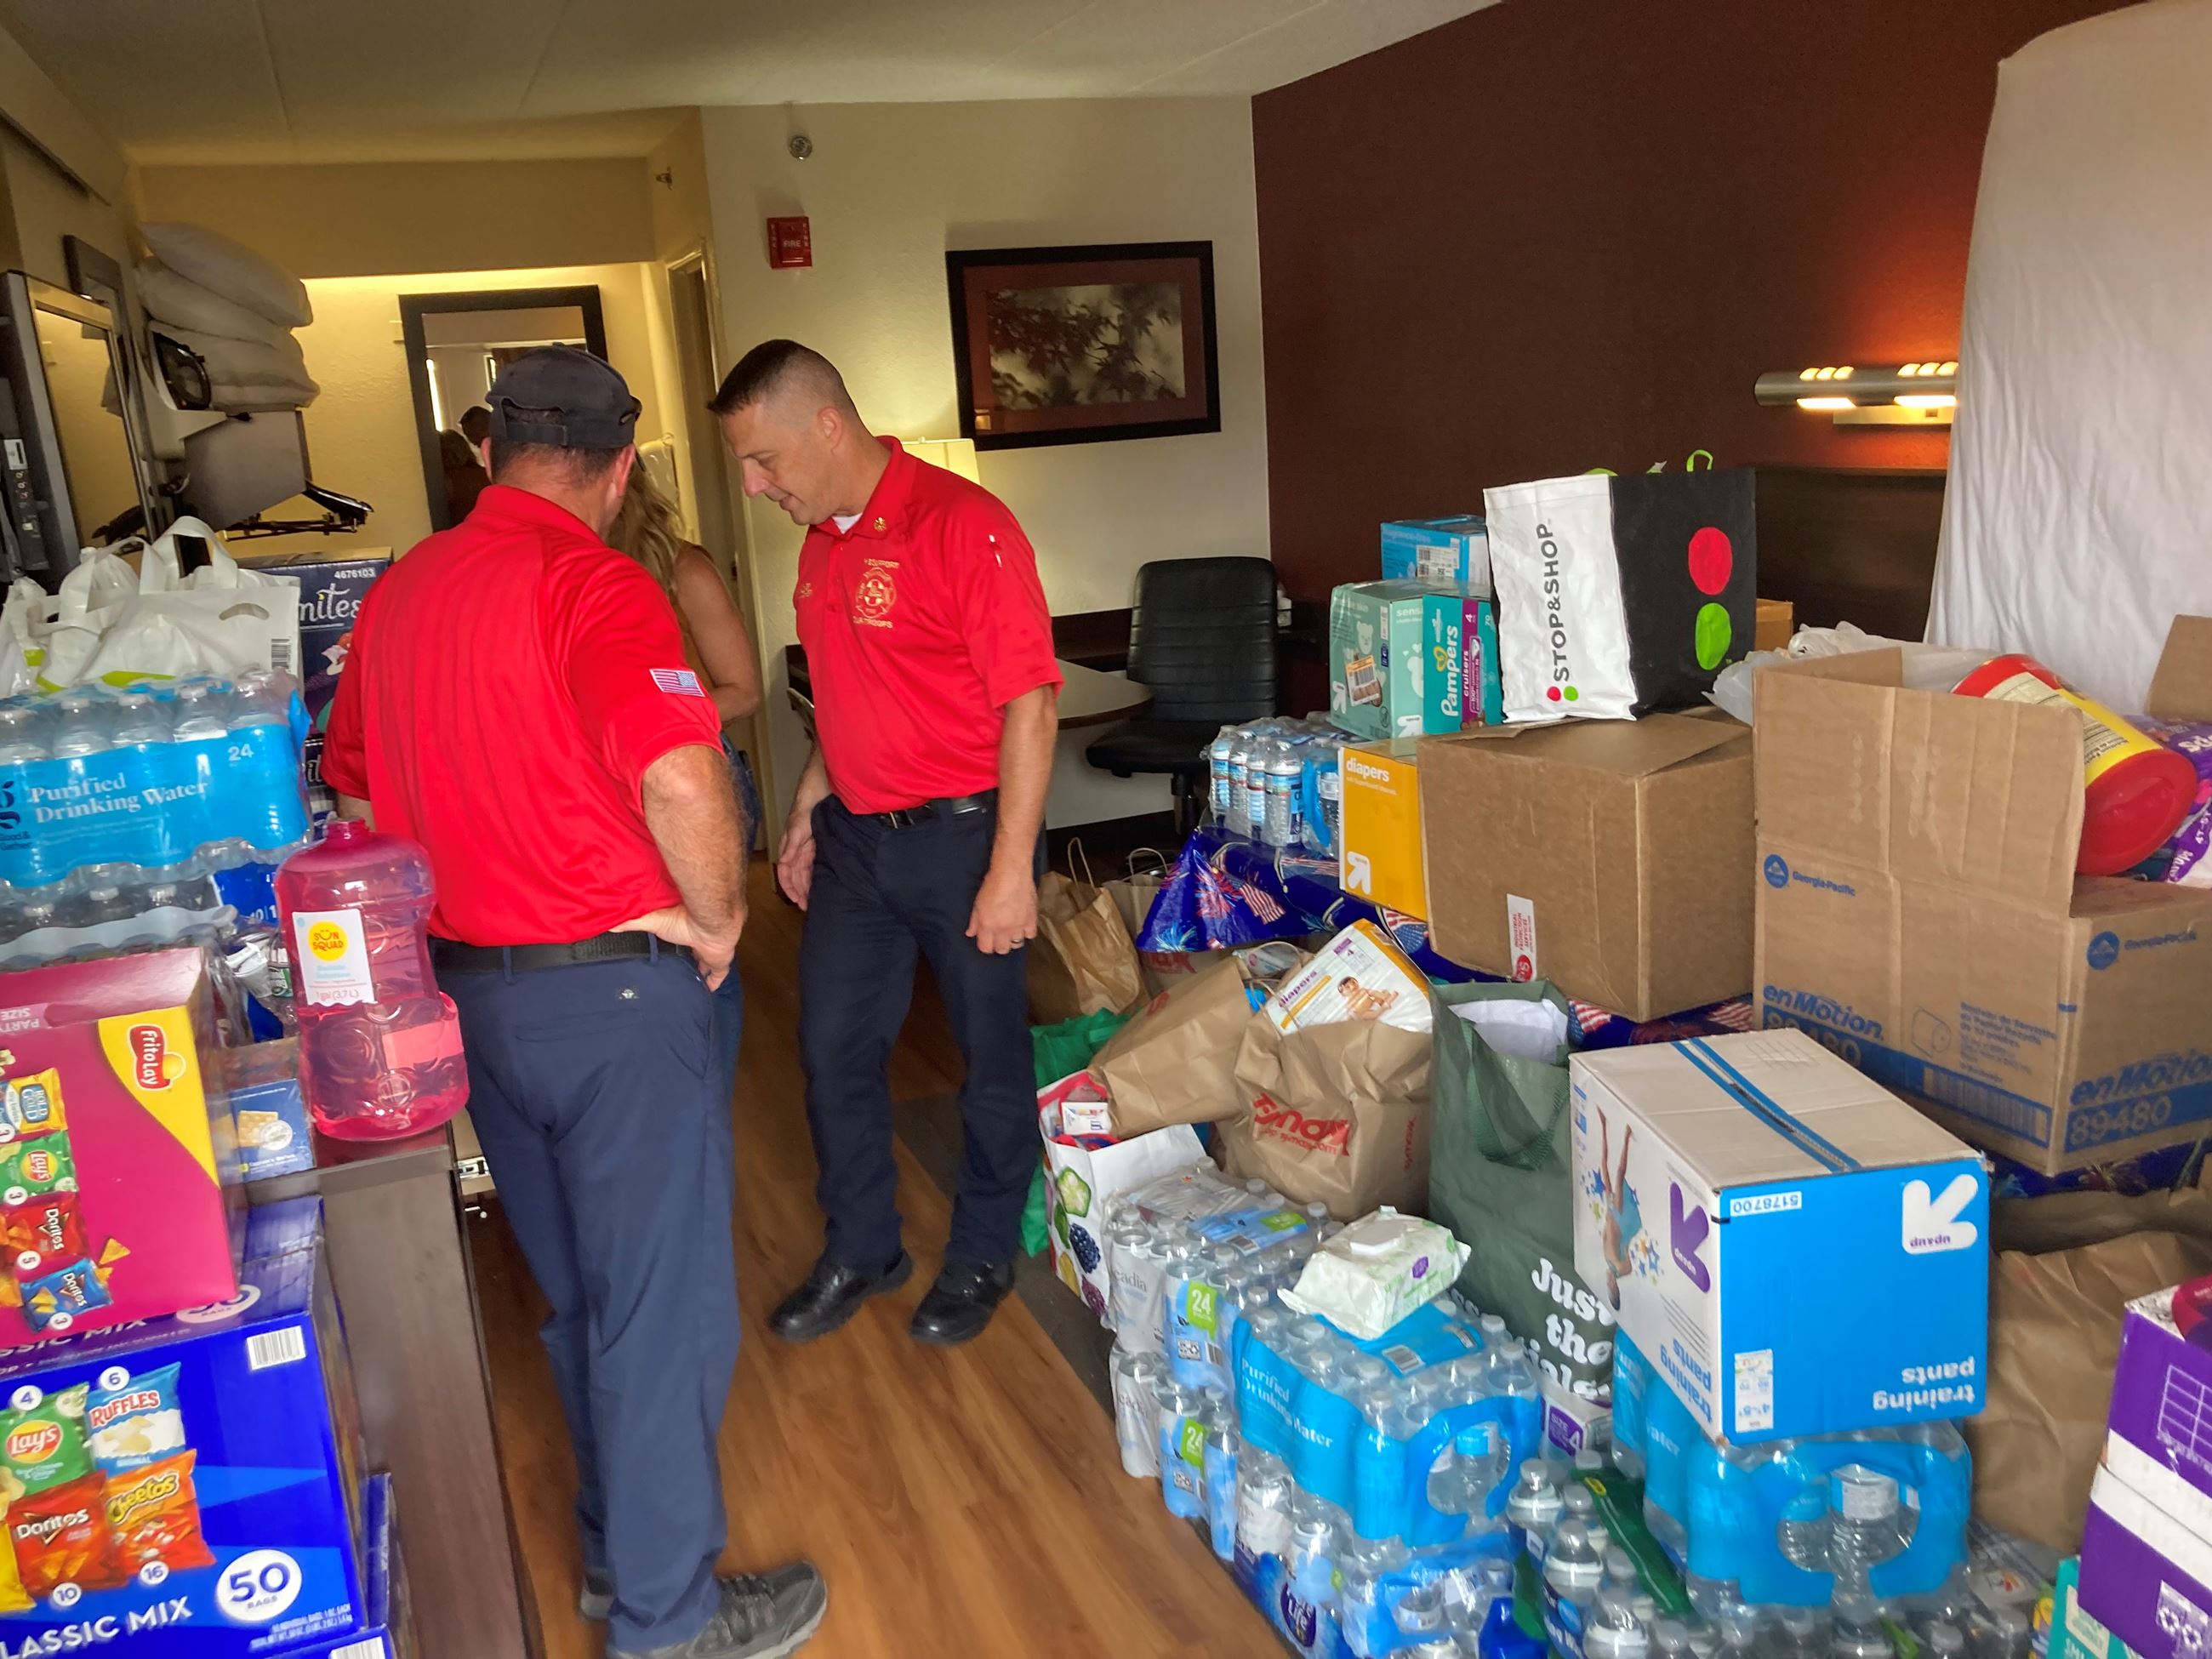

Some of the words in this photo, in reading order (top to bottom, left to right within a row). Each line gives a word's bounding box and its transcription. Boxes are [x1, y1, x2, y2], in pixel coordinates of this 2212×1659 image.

[783, 239, 801, 248] FIRE
[334, 567, 376, 579] 4676103
[1465, 613, 1473, 623] 4
[1440, 624, 1460, 716] Pampers
[227, 743, 254, 761] 24
[1346, 757, 1390, 783] diapers
[30, 772, 127, 803] Purified
[35, 794, 141, 823] Drinking
[142, 781, 208, 806] Water
[1793, 870, 1856, 897] Georgia-Pacific
[312, 940, 344, 952] SQUAD
[1279, 971, 1318, 1007] diapers
[1, 1007, 31, 1019] SIZE
[2070, 1048, 2212, 1106] enMotio
[22, 1088, 38, 1120] GOLD
[37, 1089, 48, 1117] ROLD
[2071, 1096, 2171, 1146] 89480
[1733, 1194, 1799, 1214] 5178700
[45, 1208, 65, 1251] Doritos
[1910, 1234, 1951, 1249] up&up
[22, 1256, 37, 1265] 5
[63, 1272, 88, 1307] Doritos
[1191, 1289, 1212, 1314] 24
[55, 1317, 68, 1325] 3
[108, 1371, 121, 1386] 6
[1673, 1337, 1713, 1394] pants
[1901, 1355, 1975, 1386] pants
[1241, 1357, 1291, 1403] Purified
[1660, 1342, 1713, 1424] training
[20, 1390, 34, 1405] 4
[89, 1390, 160, 1428] RUFFLES
[1873, 1383, 1975, 1413] training
[1551, 1411, 1568, 1431] SIZE
[1187, 1426, 1204, 1448] 24
[1569, 1430, 1581, 1450] 4
[107, 1474, 179, 1524] Cheetos
[16, 1508, 89, 1539] Doritos
[145, 1565, 163, 1580] 16
[229, 1562, 291, 1603] 50
[57, 1586, 77, 1602] 10
[247, 1594, 278, 1610] BAGS
[128, 1595, 193, 1633] MIX
[1287, 1599, 1308, 1631] Life
